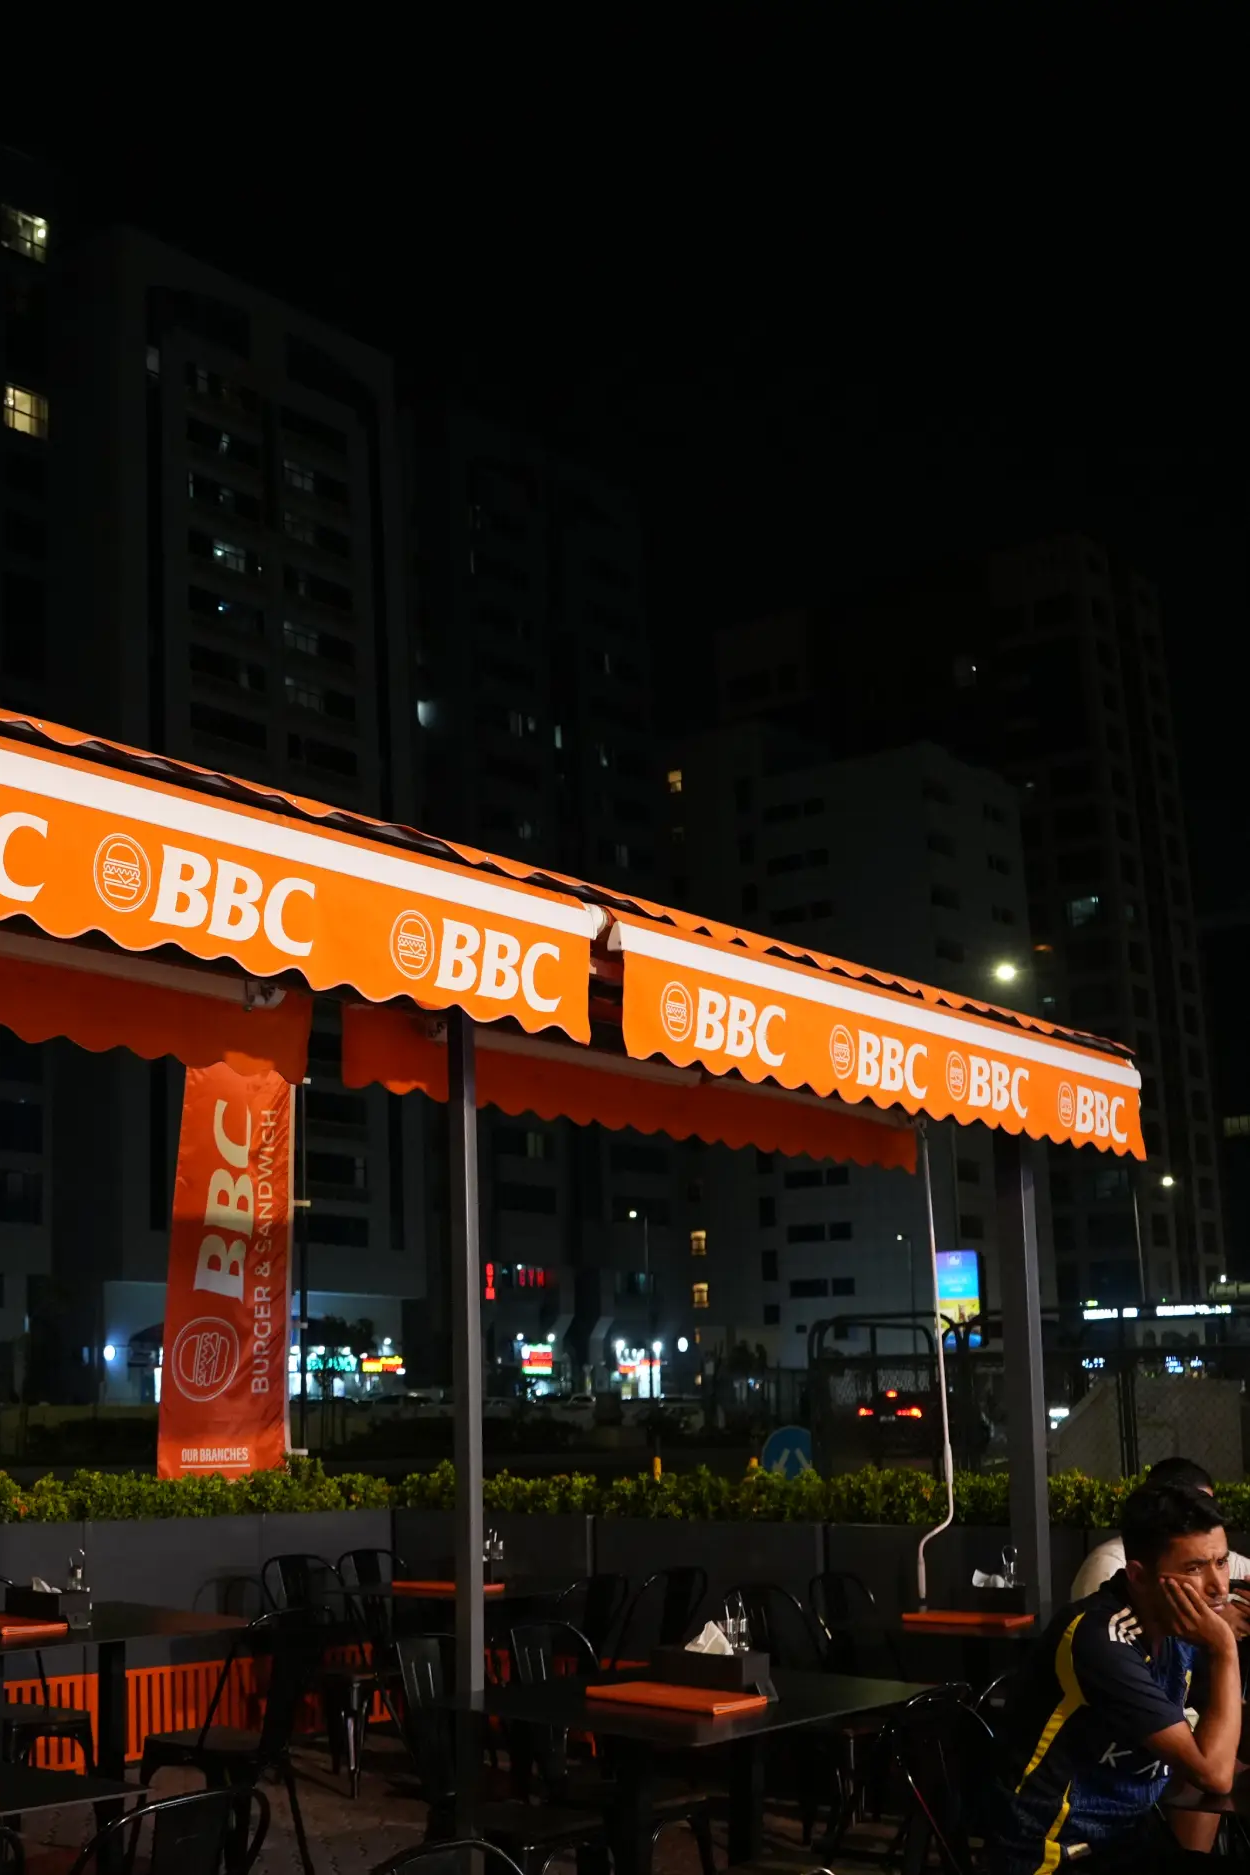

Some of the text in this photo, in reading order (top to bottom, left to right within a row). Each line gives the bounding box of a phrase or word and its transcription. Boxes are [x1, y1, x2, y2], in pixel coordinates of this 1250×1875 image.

[149, 844, 316, 957] BBC
[433, 917, 562, 1013] BBC
[693, 987, 787, 1067] BBC
[855, 1029, 928, 1100] BBC
[967, 1055, 1030, 1119] BBC
[1074, 1085, 1128, 1143] BBC
[193, 1099, 255, 1304] BBC
[251, 1109, 279, 1395] BURGER & SANDWICH
[181, 1446, 249, 1463] OUR BRANCHES
